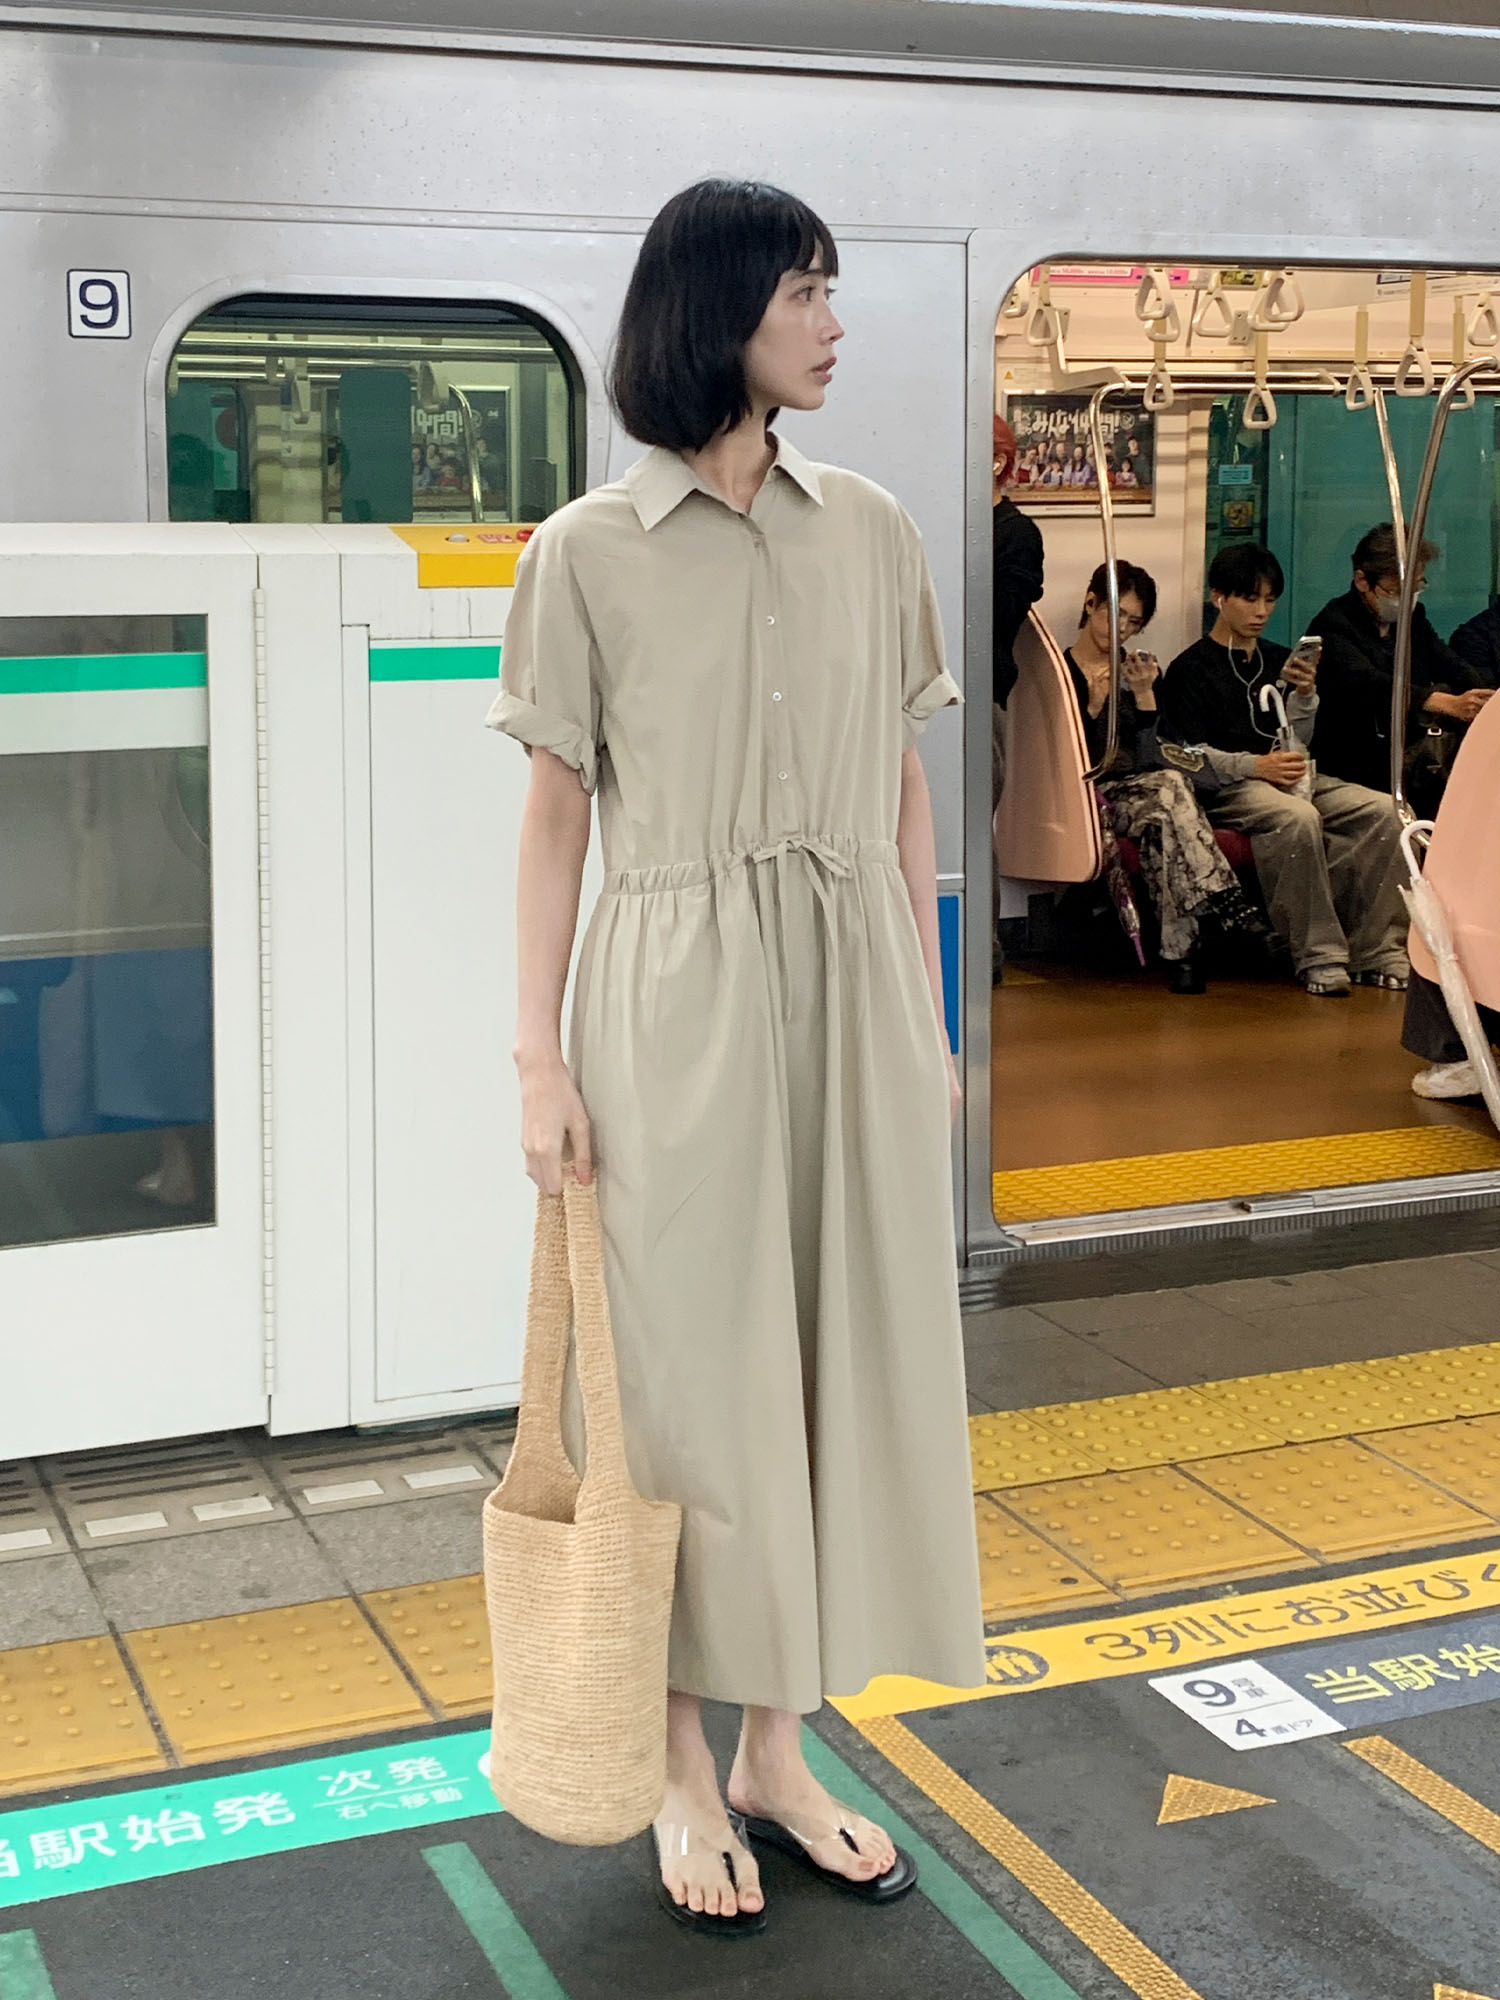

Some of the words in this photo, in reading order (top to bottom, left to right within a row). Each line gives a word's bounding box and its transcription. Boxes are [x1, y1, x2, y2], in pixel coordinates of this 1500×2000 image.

[78, 278, 119, 329] 9
[317, 1756, 447, 1797] 次発
[336, 1786, 463, 1820] 右へ移動
[0, 1791, 296, 1878] 駅始発
